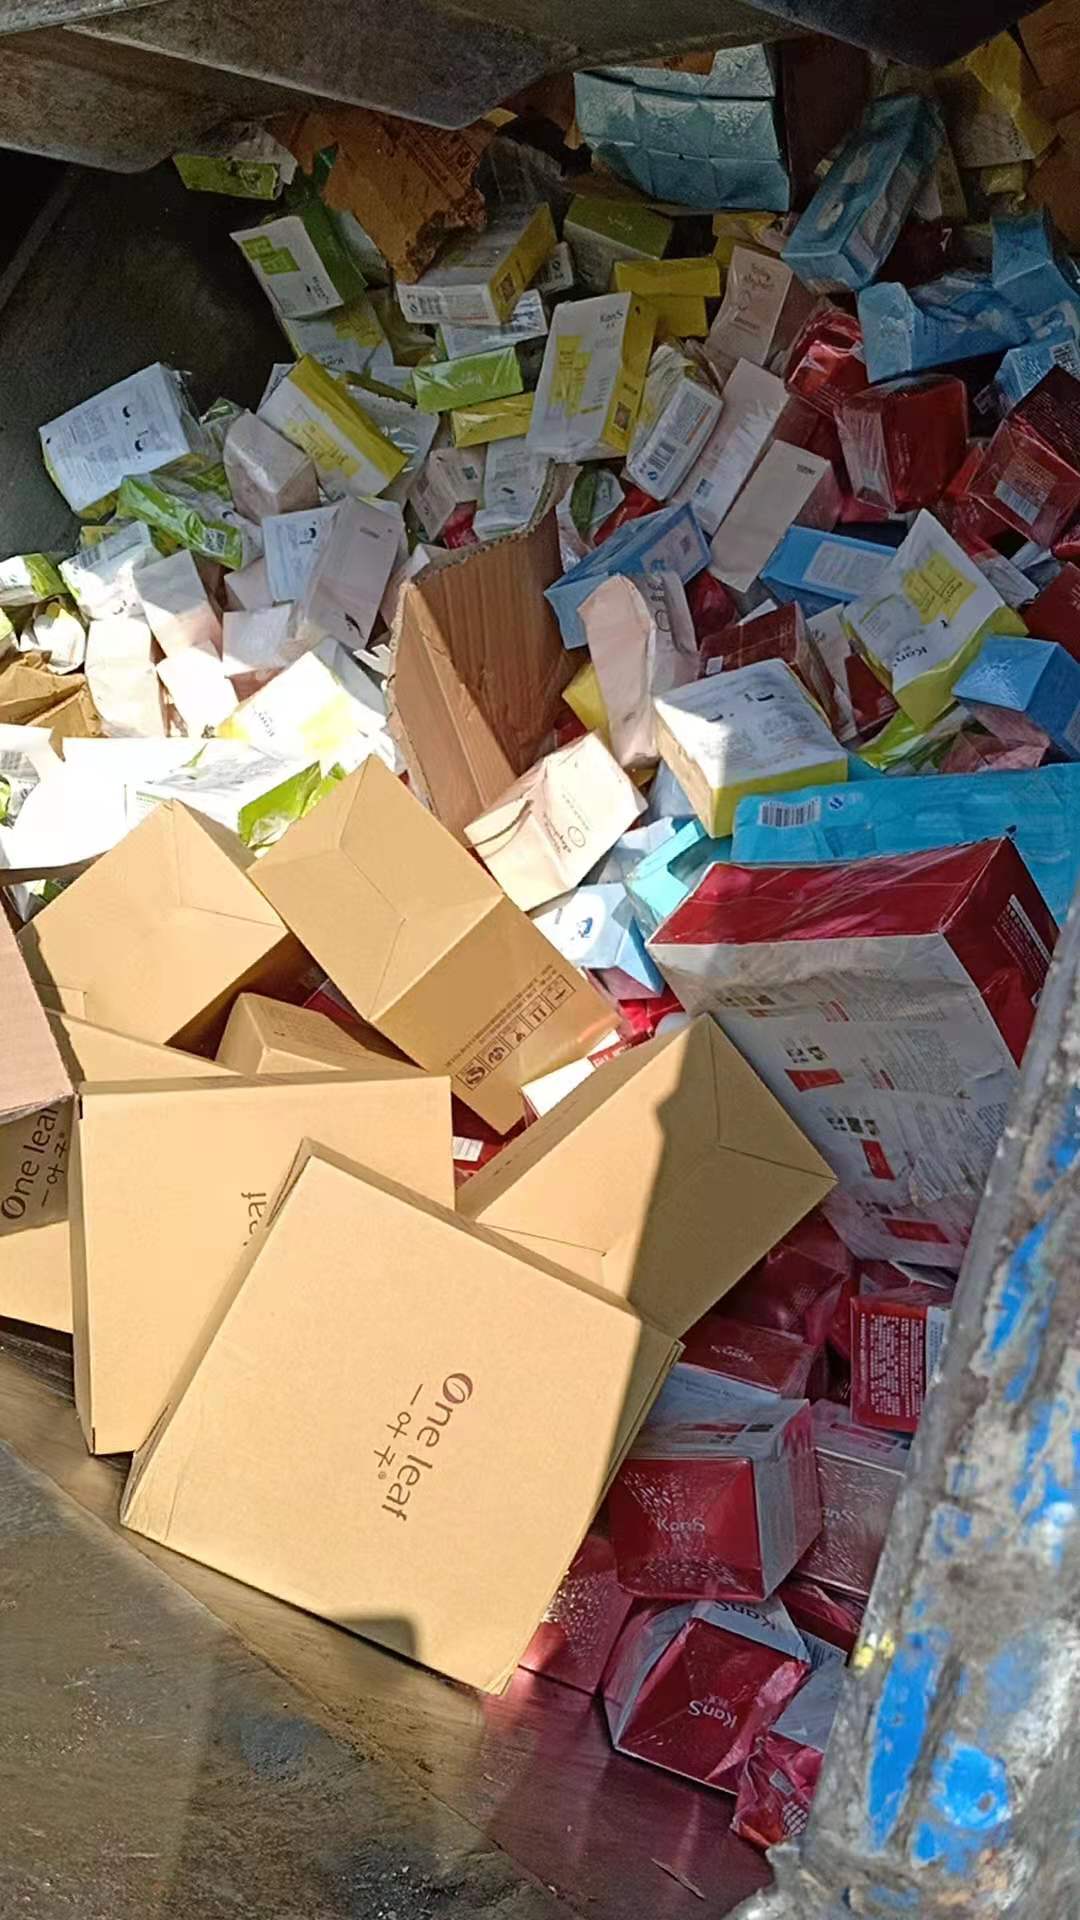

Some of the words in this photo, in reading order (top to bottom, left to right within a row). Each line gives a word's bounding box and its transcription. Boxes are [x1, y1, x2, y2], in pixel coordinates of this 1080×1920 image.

[2, 1158, 40, 1219] One
[418, 1373, 474, 1448] One
[381, 1455, 433, 1521] leaf
[655, 1516, 706, 1533] KanS
[687, 1698, 738, 1729] KanS
